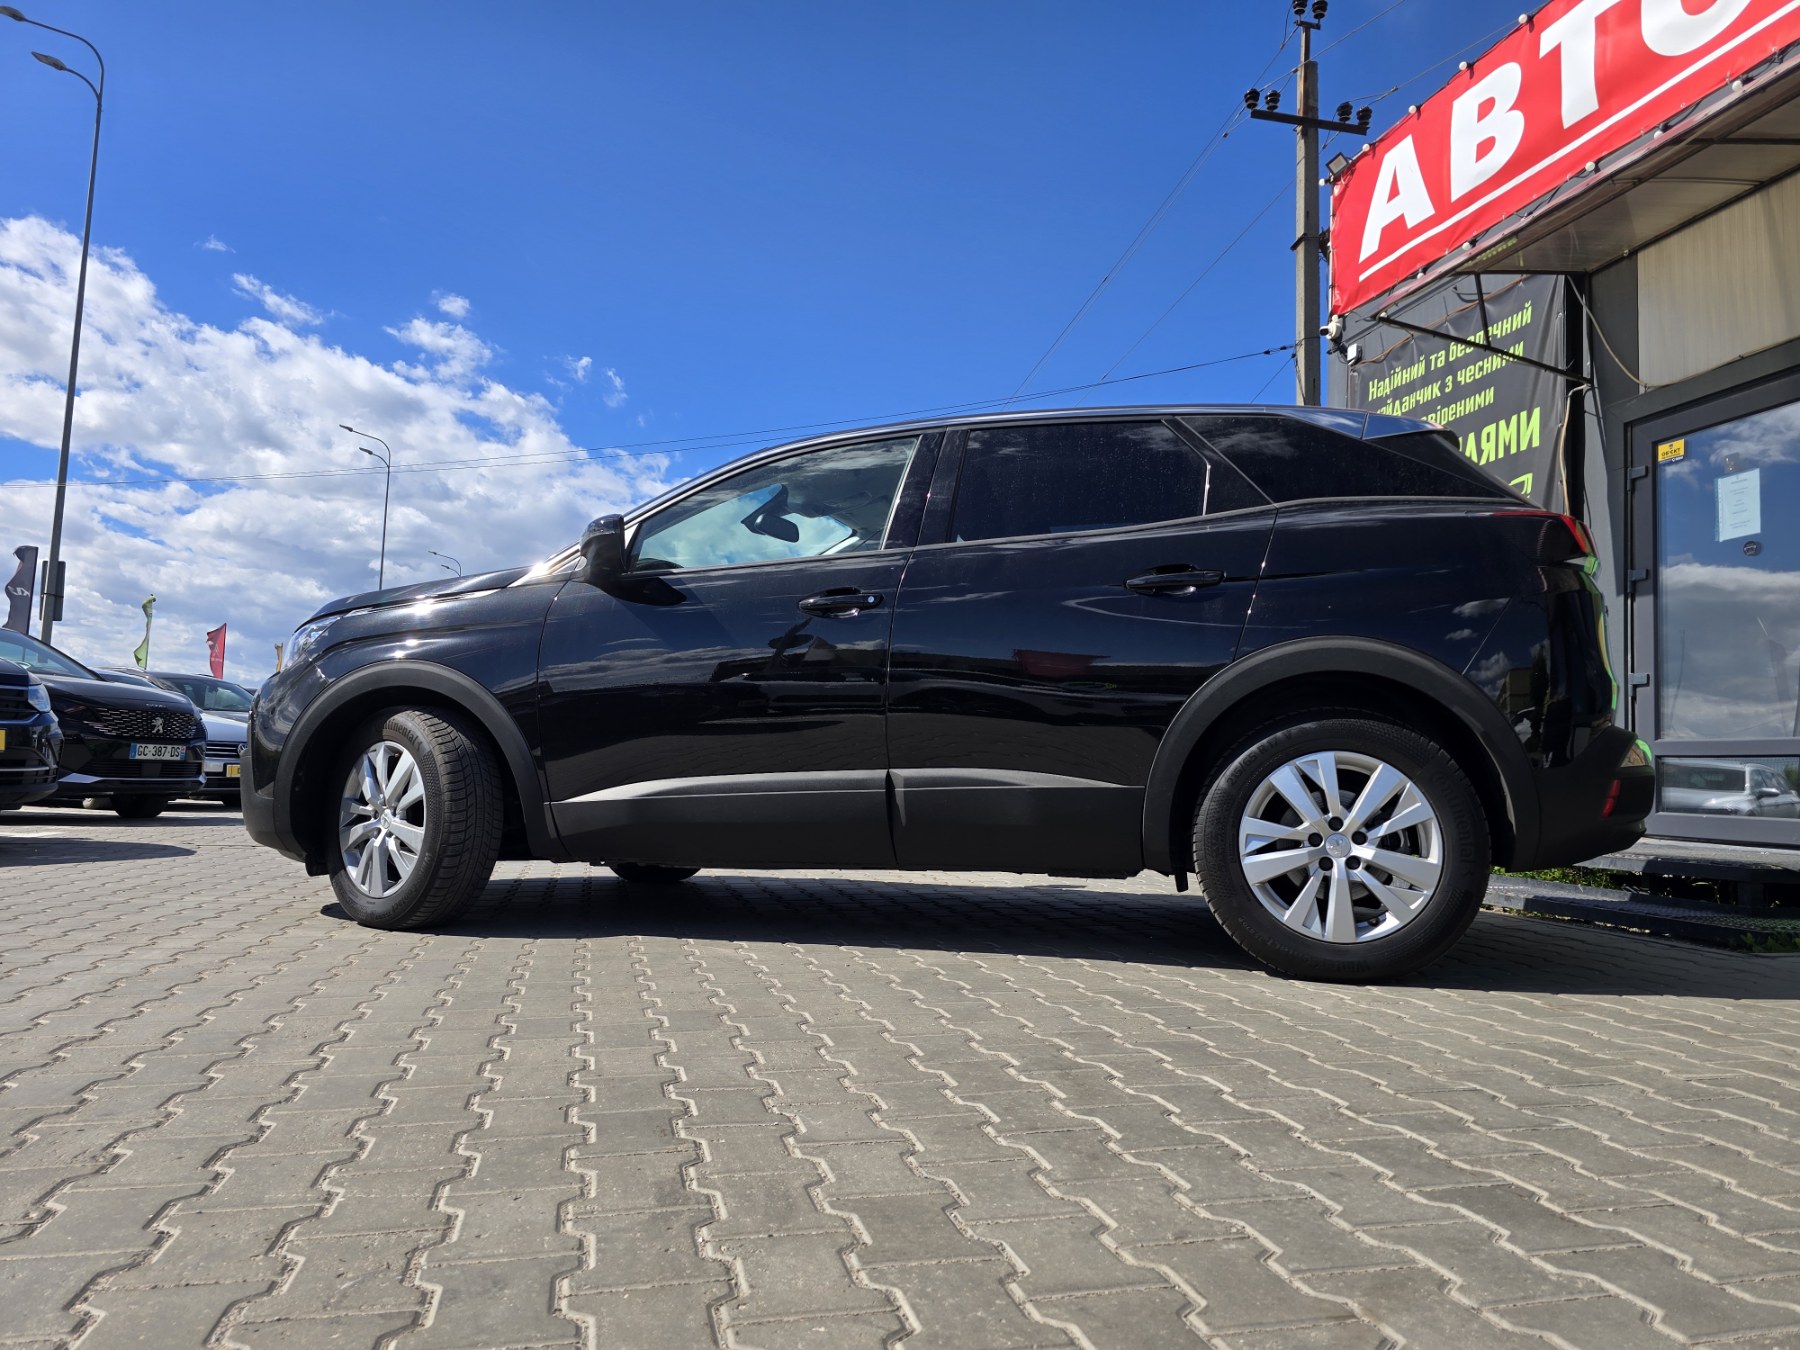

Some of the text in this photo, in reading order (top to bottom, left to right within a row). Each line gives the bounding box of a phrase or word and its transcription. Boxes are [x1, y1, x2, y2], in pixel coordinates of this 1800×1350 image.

[1368, 355, 1426, 401] Надійний
[1429, 350, 1446, 371] та
[1376, 380, 1441, 417] йданчик
[1421, 386, 1495, 426] віреними
[1458, 406, 1541, 466] ЛЯМИ
